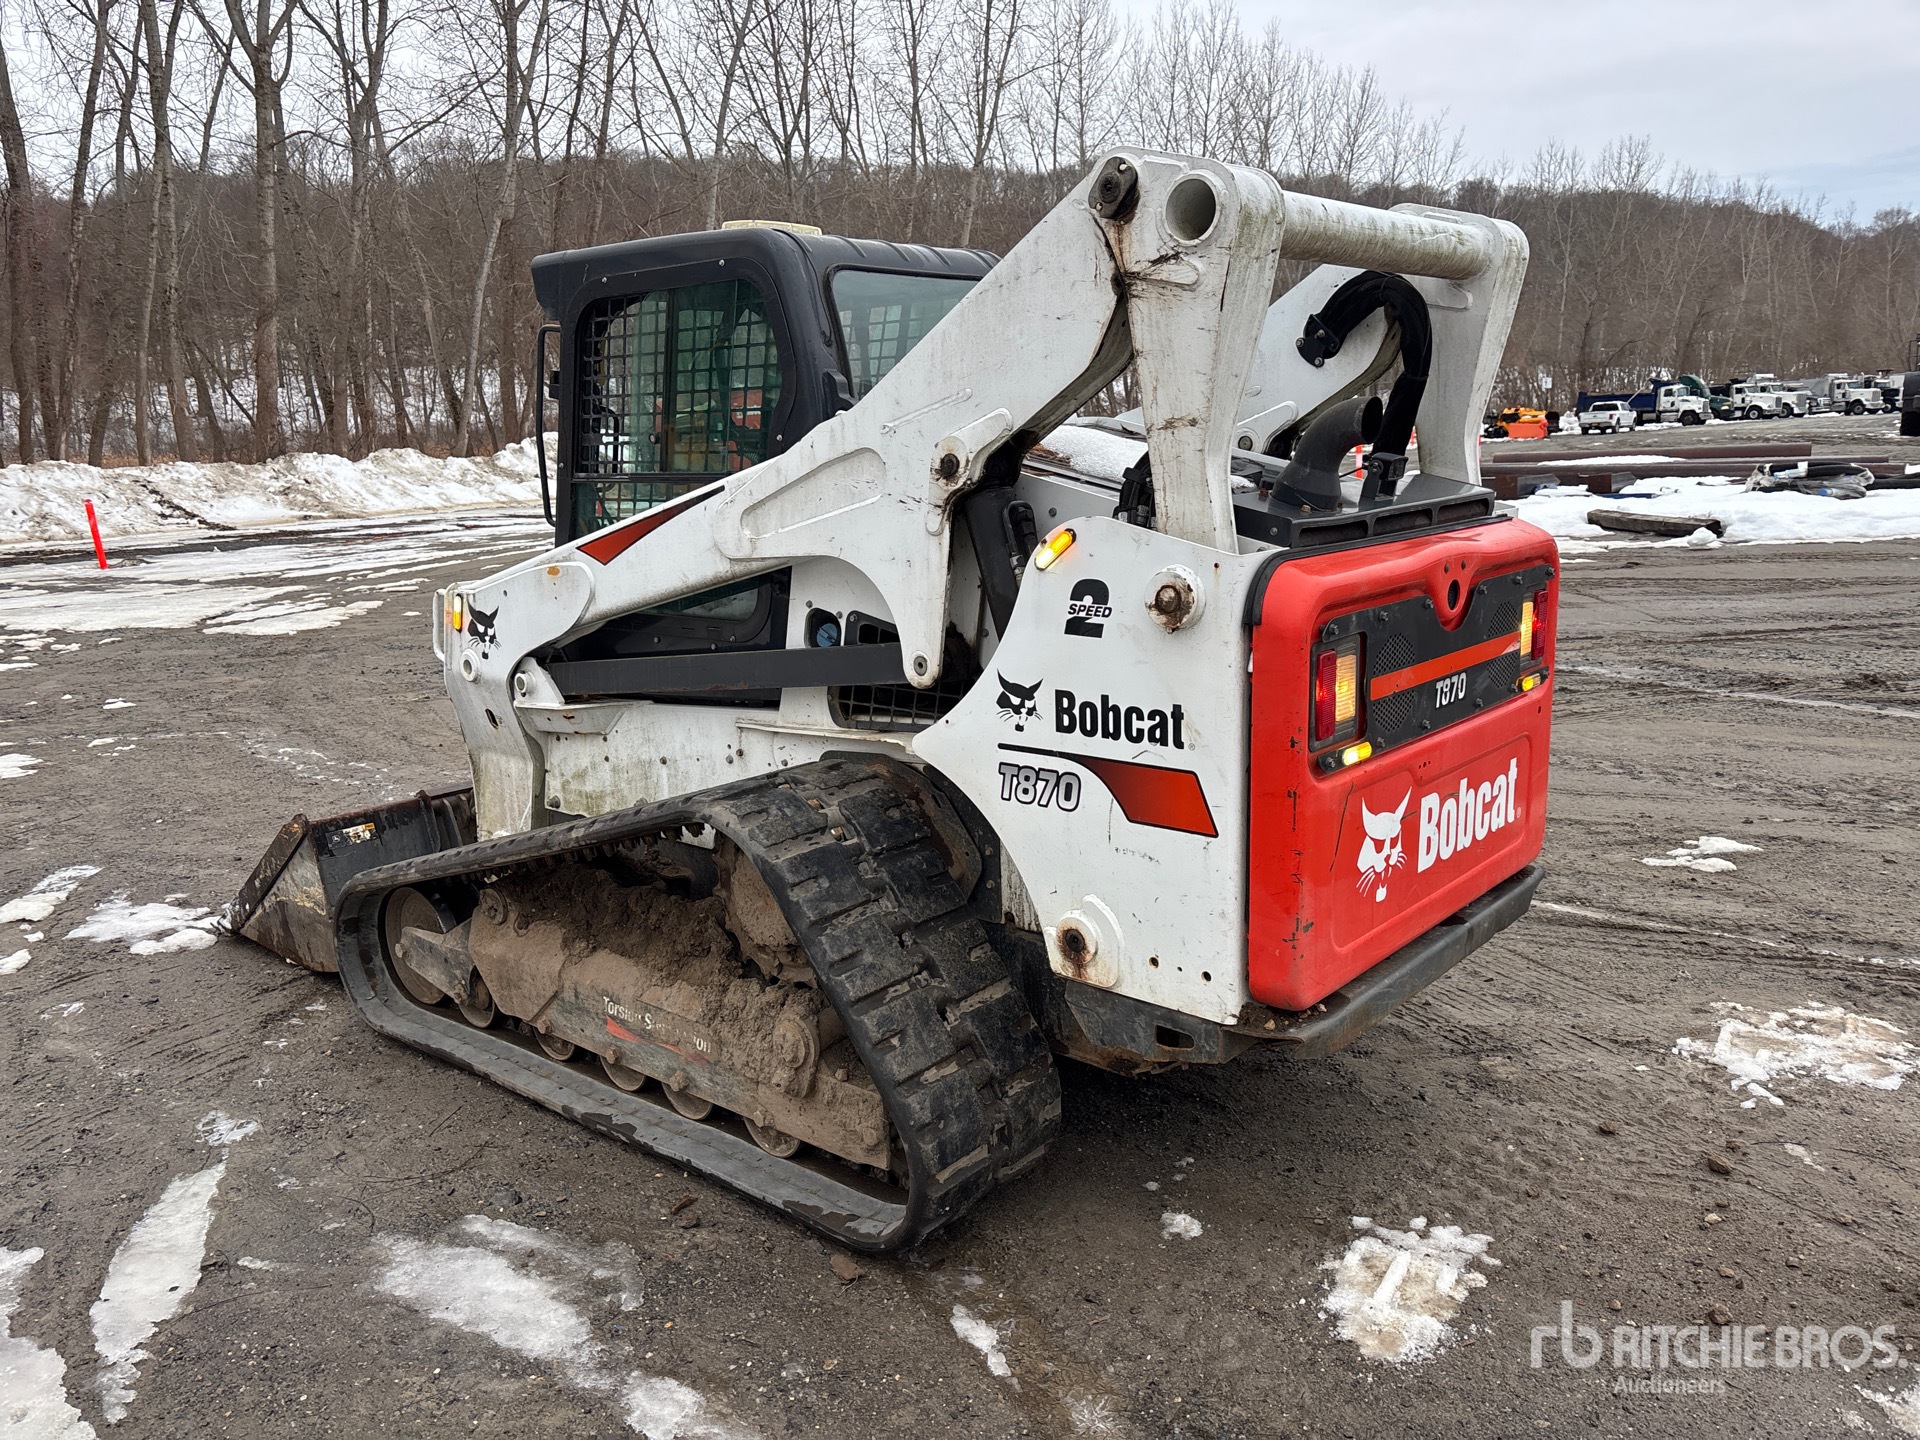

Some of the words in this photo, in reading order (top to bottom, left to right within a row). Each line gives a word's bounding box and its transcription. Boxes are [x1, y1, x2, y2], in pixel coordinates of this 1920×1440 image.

[1064, 578, 1110, 638] 2
[1068, 603, 1112, 618] SPEED
[1435, 672, 1467, 709] T870
[1055, 689, 1185, 750] Bobcat
[998, 762, 1081, 812] T870
[1417, 757, 1518, 873] Bobcat
